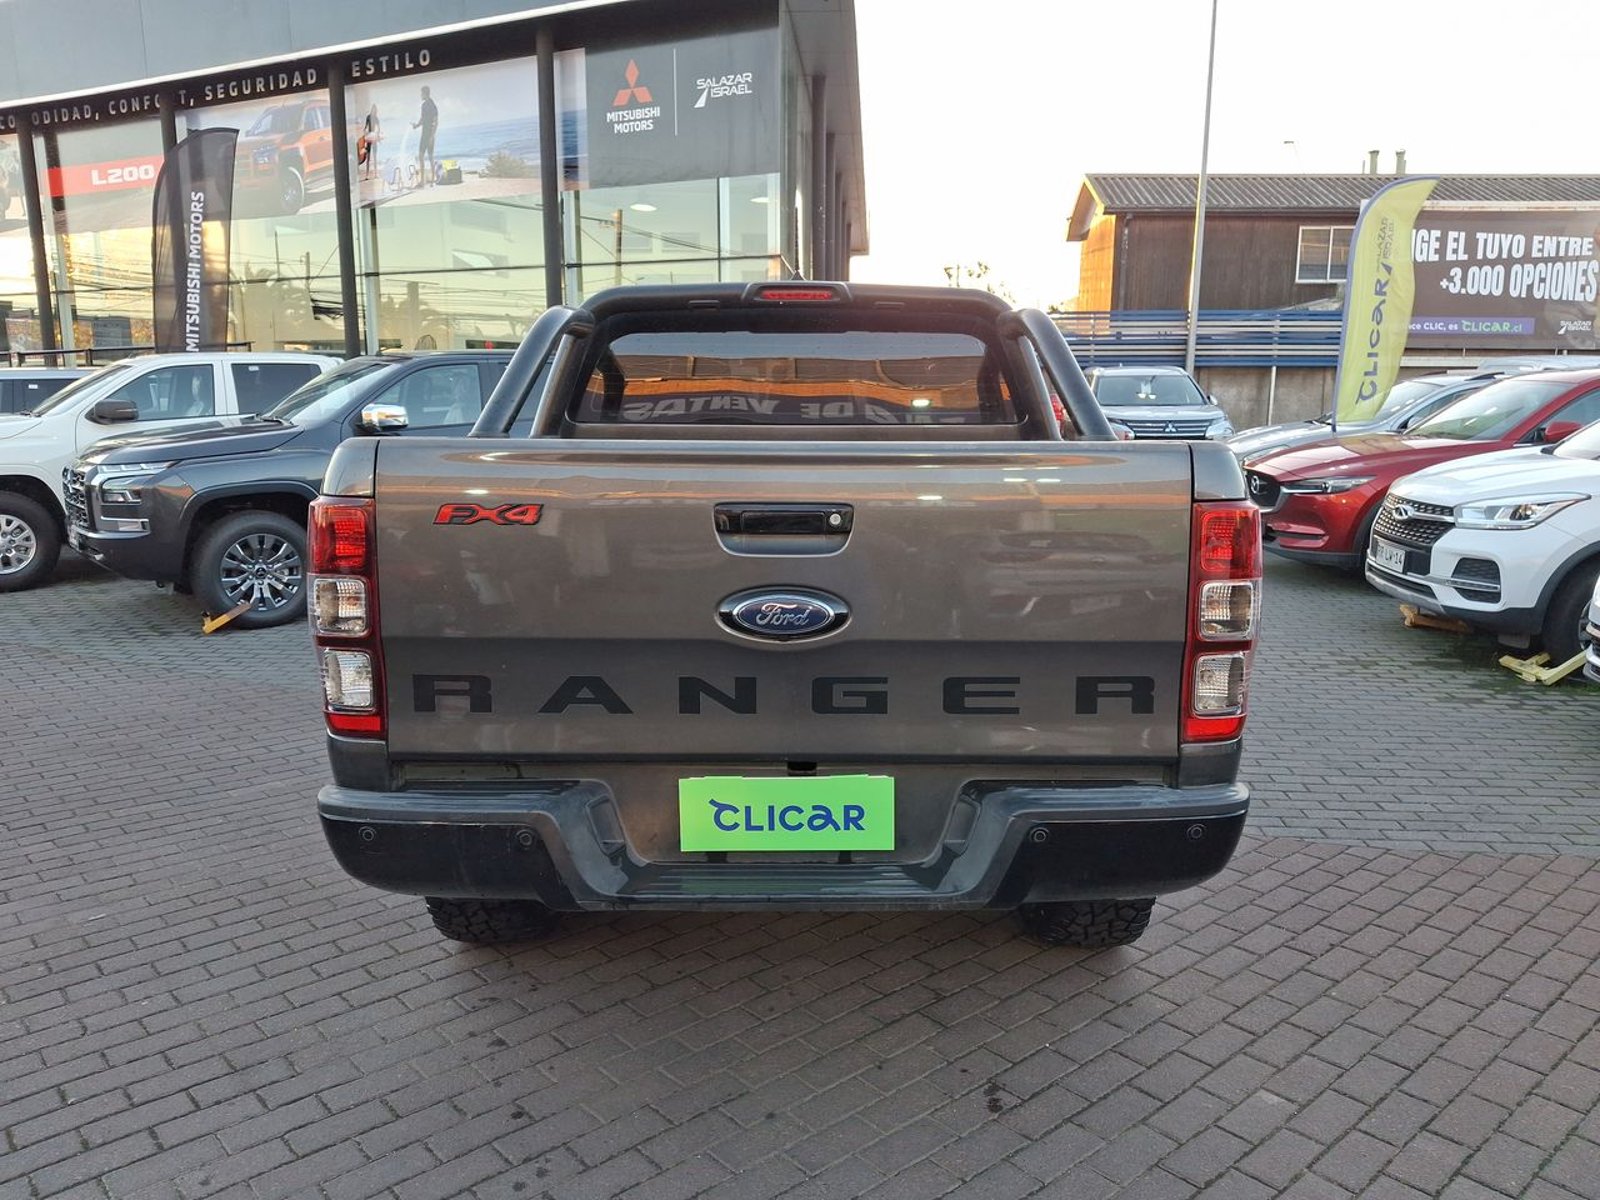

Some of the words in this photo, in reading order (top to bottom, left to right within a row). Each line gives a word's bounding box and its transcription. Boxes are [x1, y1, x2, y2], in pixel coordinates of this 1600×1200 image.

[0, 105, 99, 130] COODIDAD,
[108, 90, 194, 115] CONFOT,
[204, 69, 317, 100] SEGURIDAD
[352, 49, 431, 77] ESTILO
[696, 72, 752, 89] SALAZAR
[711, 84, 752, 98] ISRAEL
[606, 106, 661, 123] MITSUBISHI
[614, 119, 654, 134] MOTORS
[91, 164, 155, 186] L200
[189, 191, 204, 259] MOTORS
[1446, 231, 1468, 261] EL
[1476, 232, 1526, 260] TUYO
[1531, 235, 1594, 258] ENTRE
[1440, 264, 1505, 297] +3.000
[1509, 260, 1599, 302] OPCIONES
[186, 263, 201, 352] MITSUBISHI
[1423, 321, 1447, 332] CLIC,
[1448, 323, 1459, 331] es
[433, 503, 544, 525] FX4
[755, 602, 813, 626] Ford
[412, 673, 1155, 715] RANGER
